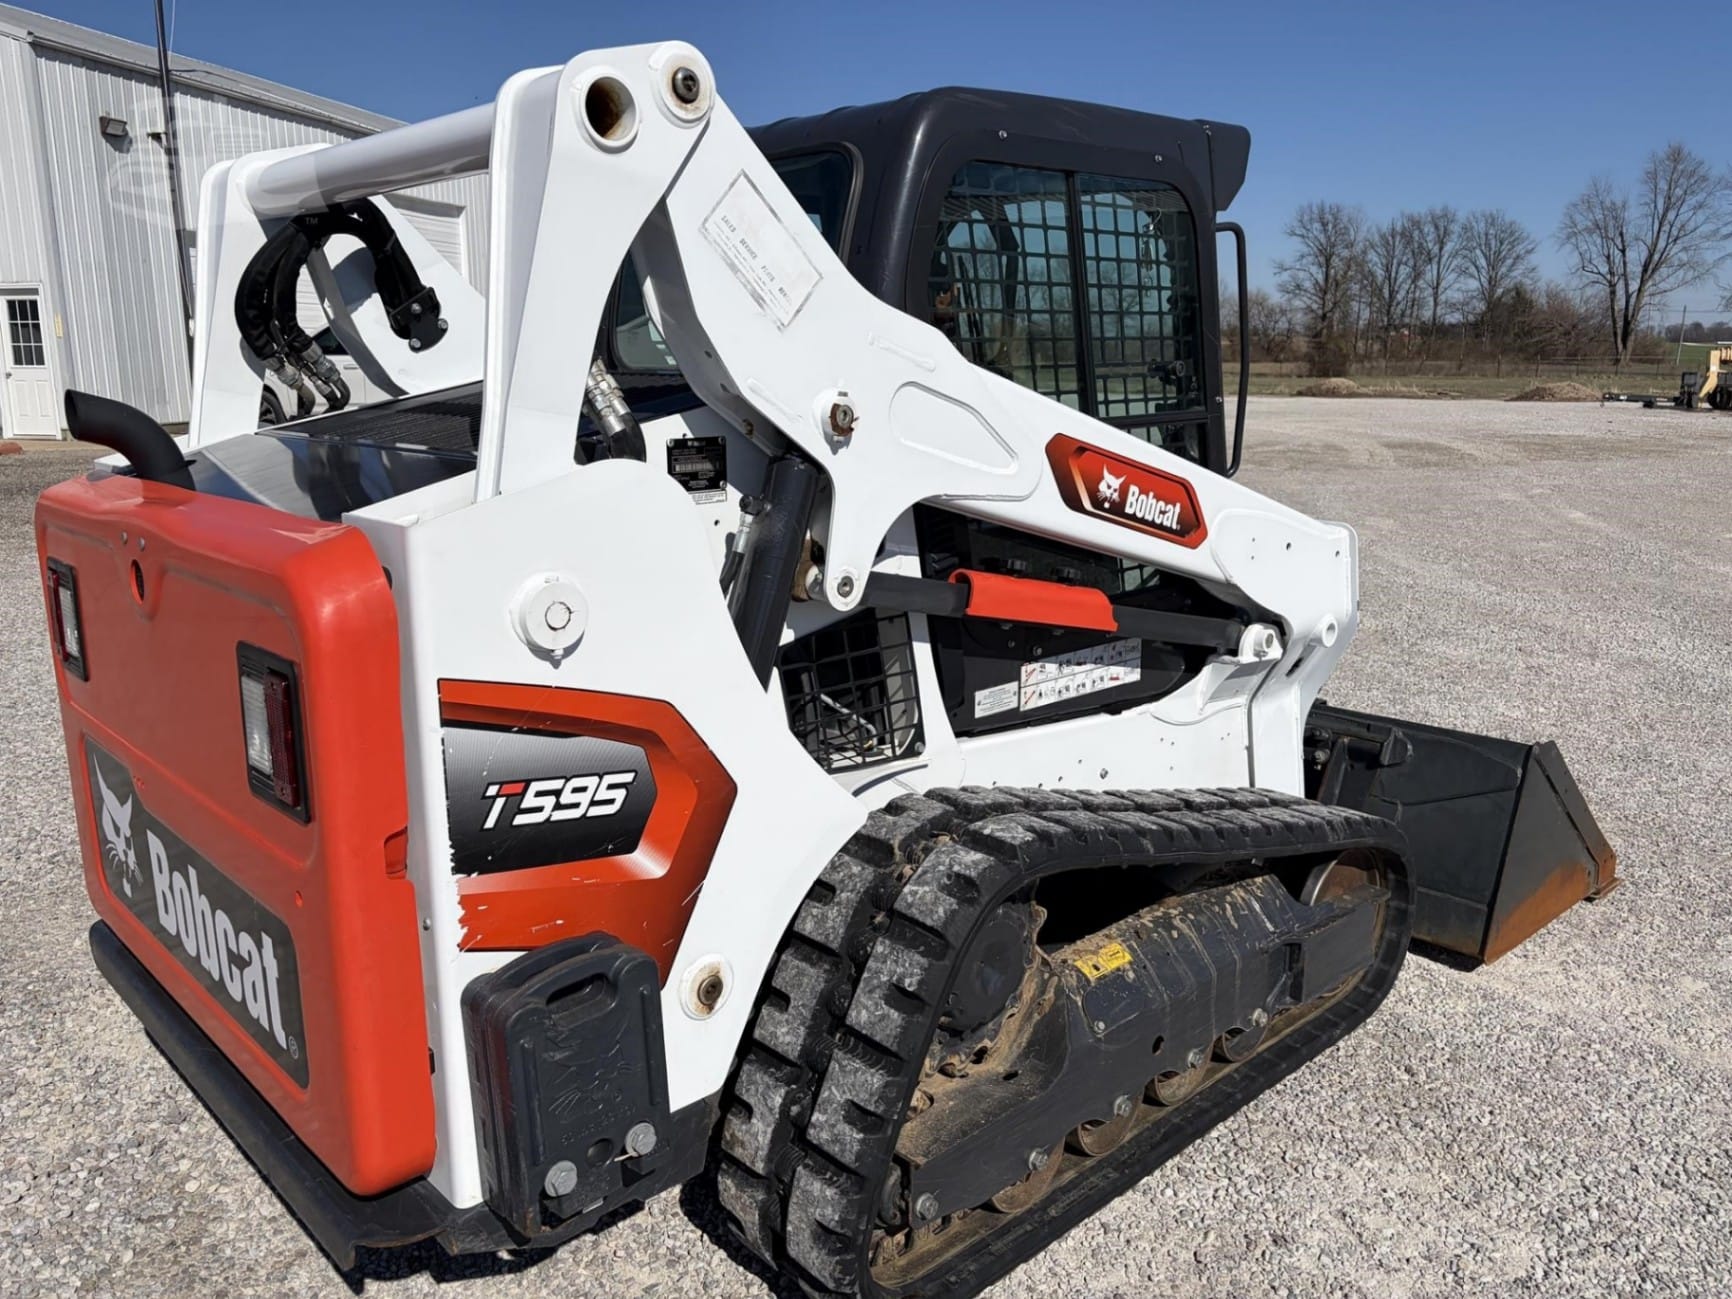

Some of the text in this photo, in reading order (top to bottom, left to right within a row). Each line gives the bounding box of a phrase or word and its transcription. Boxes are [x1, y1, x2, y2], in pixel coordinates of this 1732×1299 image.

[720, 215, 736, 233] SALES
[739, 238, 758, 260] SERVICE
[1124, 484, 1181, 530] Bobcat
[483, 772, 636, 829] T595
[146, 828, 287, 1050] Bobcat
